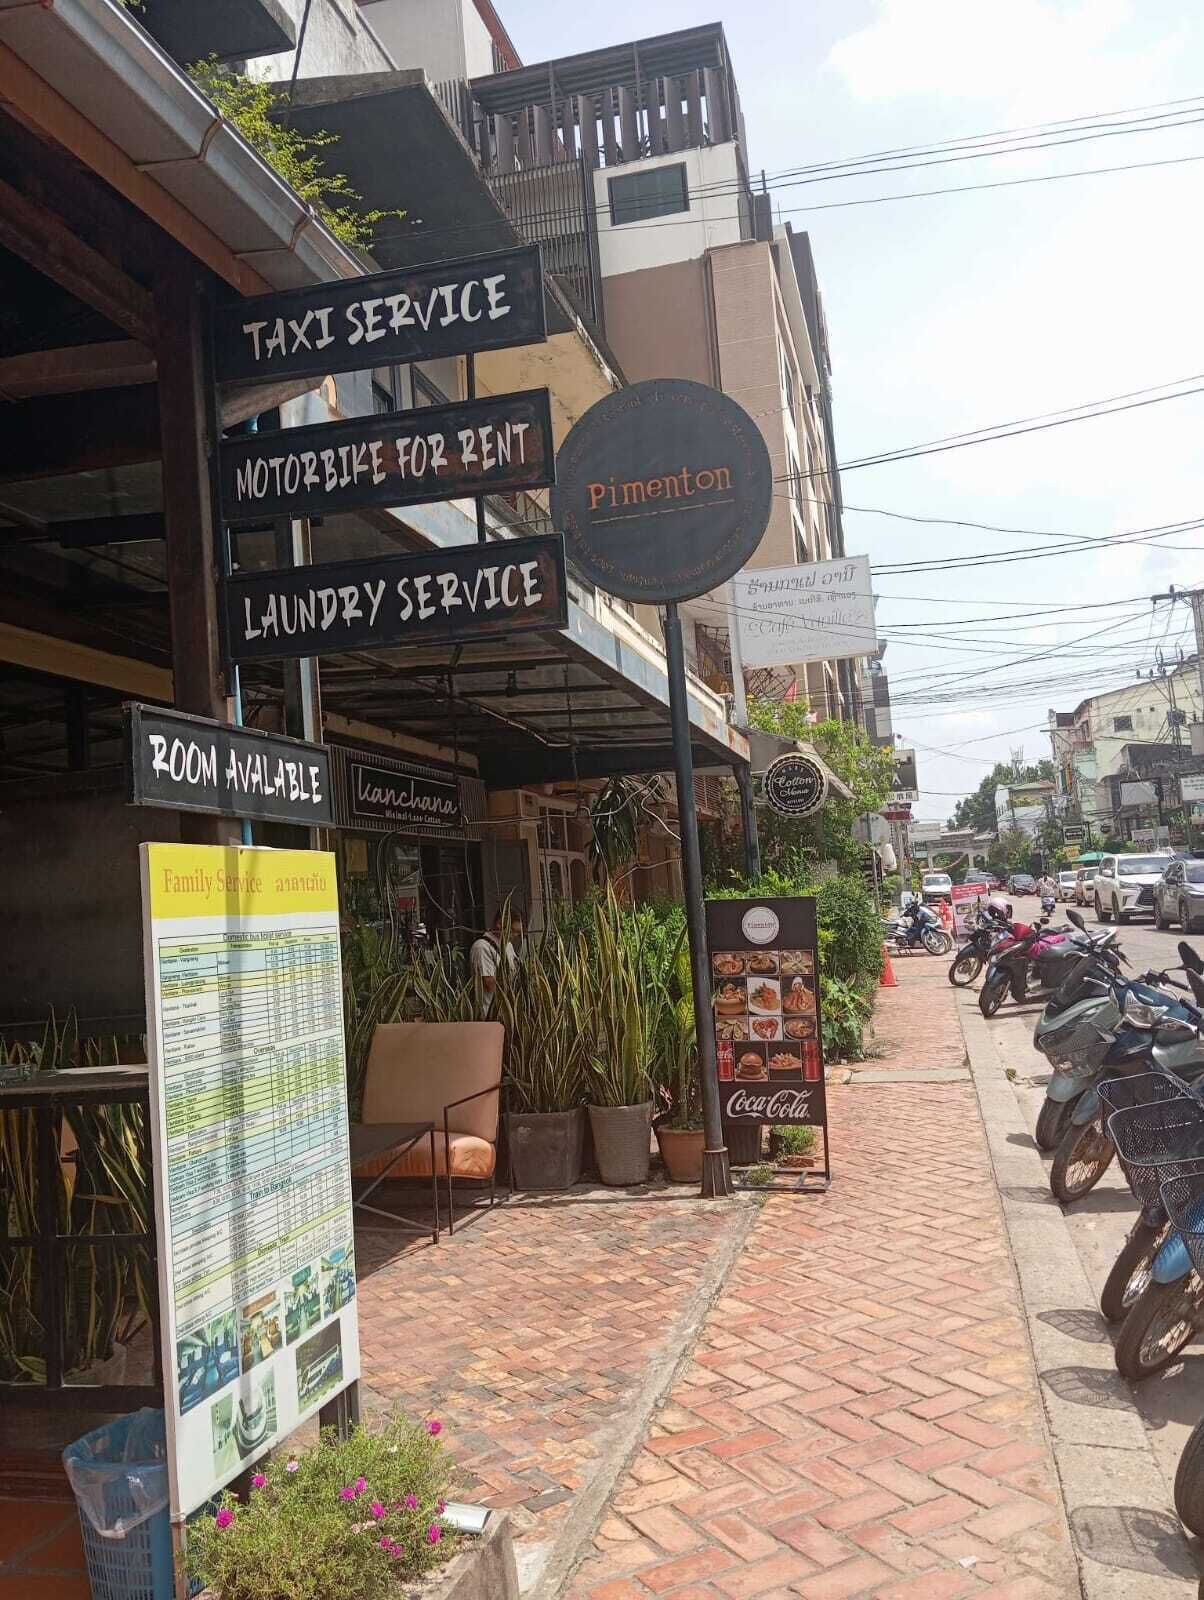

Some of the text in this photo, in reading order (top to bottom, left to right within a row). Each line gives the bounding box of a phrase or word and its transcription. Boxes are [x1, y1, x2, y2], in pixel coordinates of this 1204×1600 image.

[242, 274, 511, 361] TAXI SERVICE
[236, 440, 388, 500] MOTORBIKE
[397, 432, 448, 480] FOR
[458, 423, 530, 474] RENT
[587, 465, 735, 511] Pimenton
[244, 560, 543, 641] LAUNDRY SERVICE
[148, 734, 323, 803] ROOM AVALABLE
[358, 767, 458, 814] kanchana
[163, 868, 263, 899] Family Service
[726, 1089, 813, 1119] Coca-Cola
